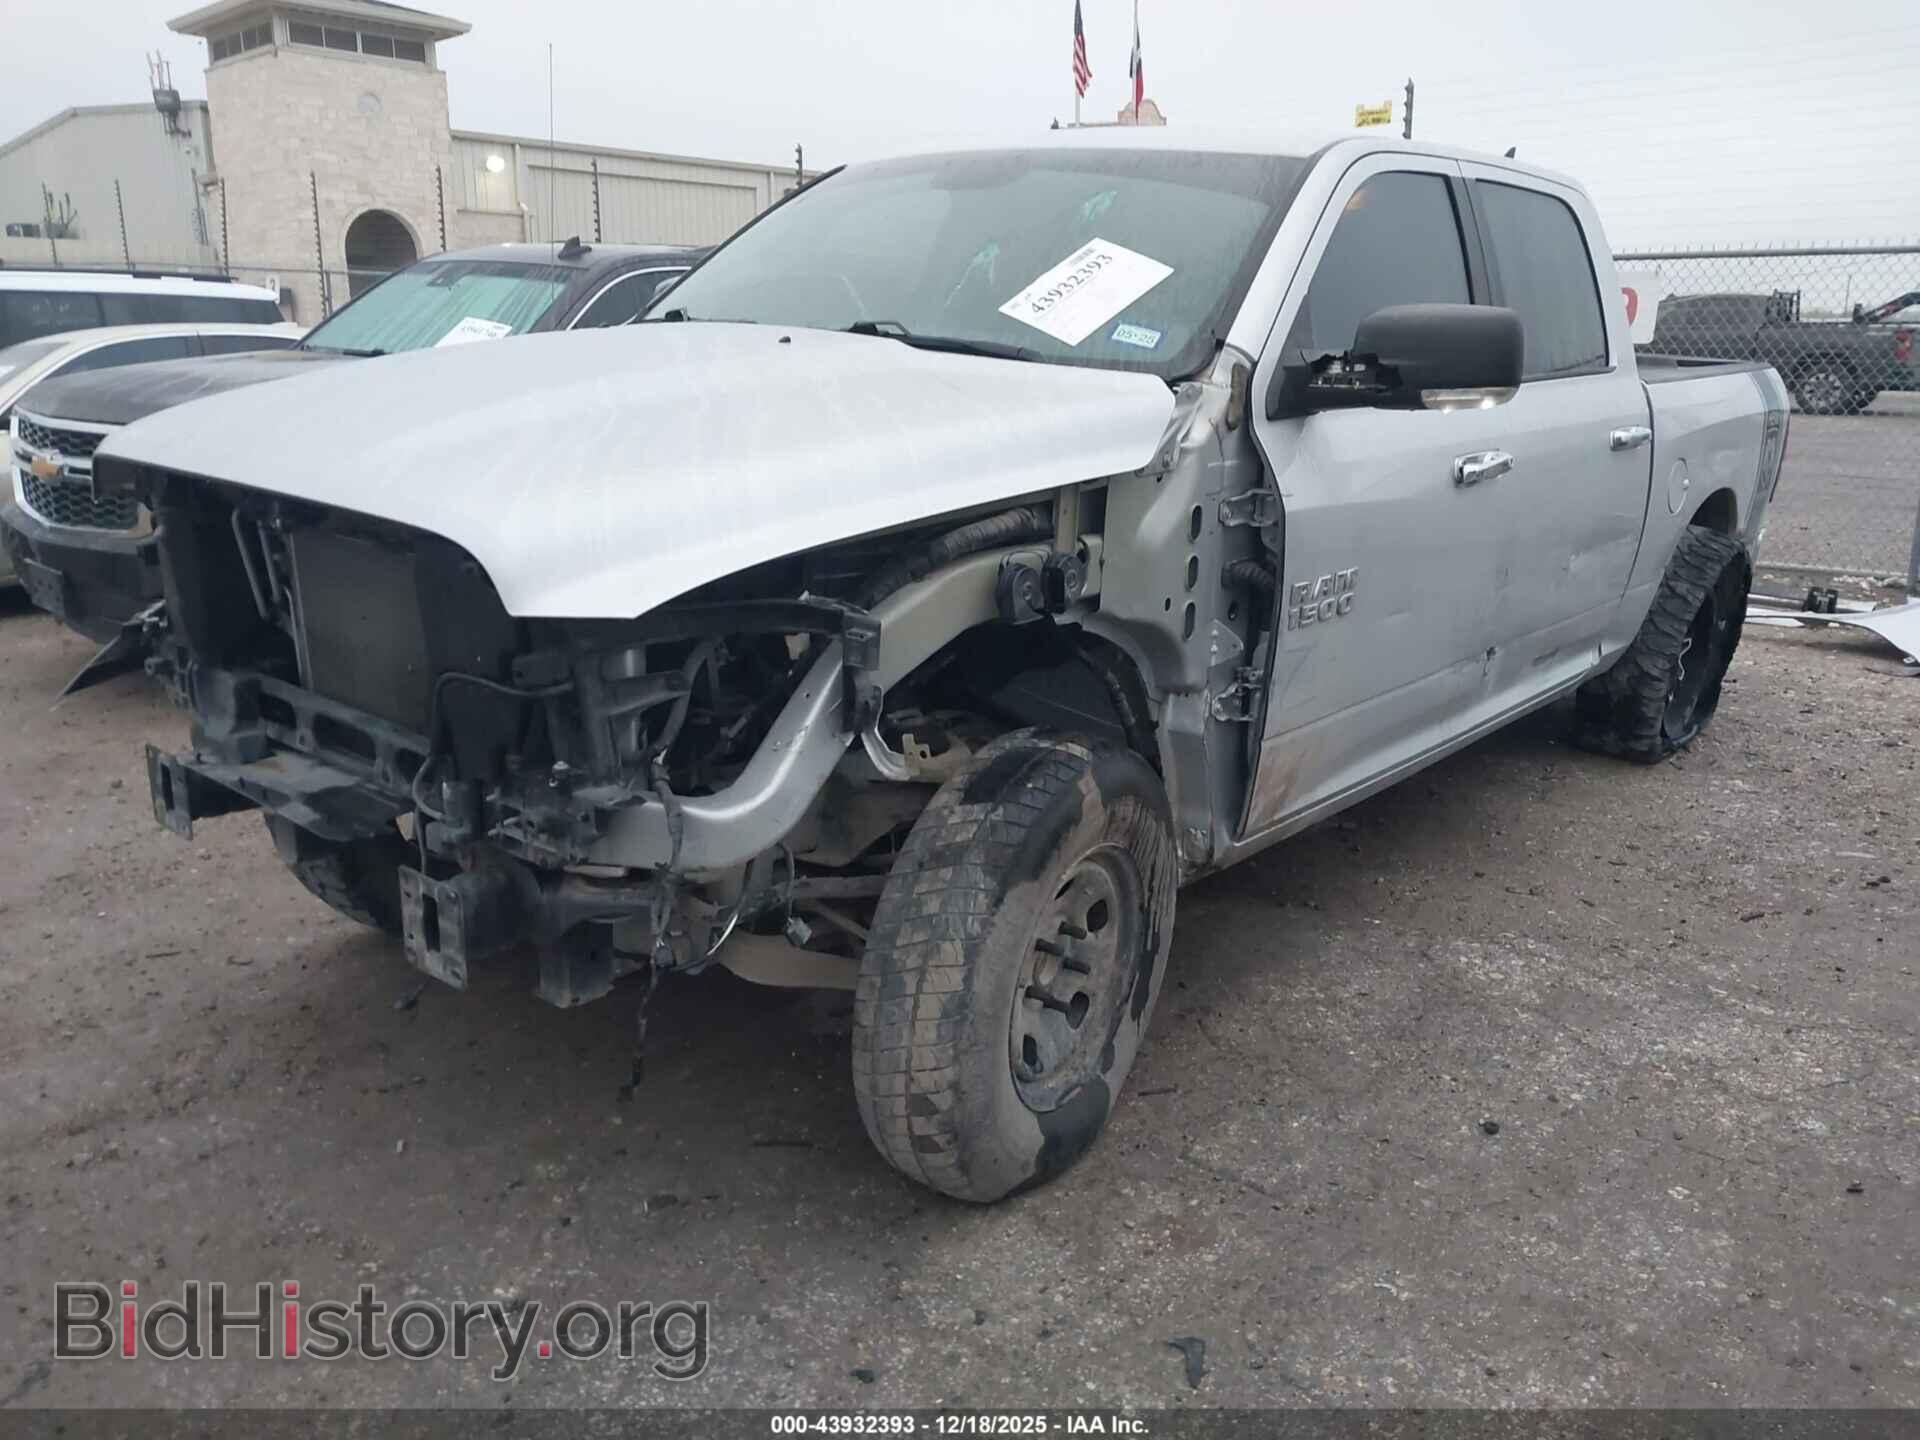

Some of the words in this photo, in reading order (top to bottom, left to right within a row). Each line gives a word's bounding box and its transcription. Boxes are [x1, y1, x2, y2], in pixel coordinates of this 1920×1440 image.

[1031, 253, 1113, 315] 43932393
[1289, 567, 1359, 607] RAM
[1287, 592, 1354, 631] 1500
